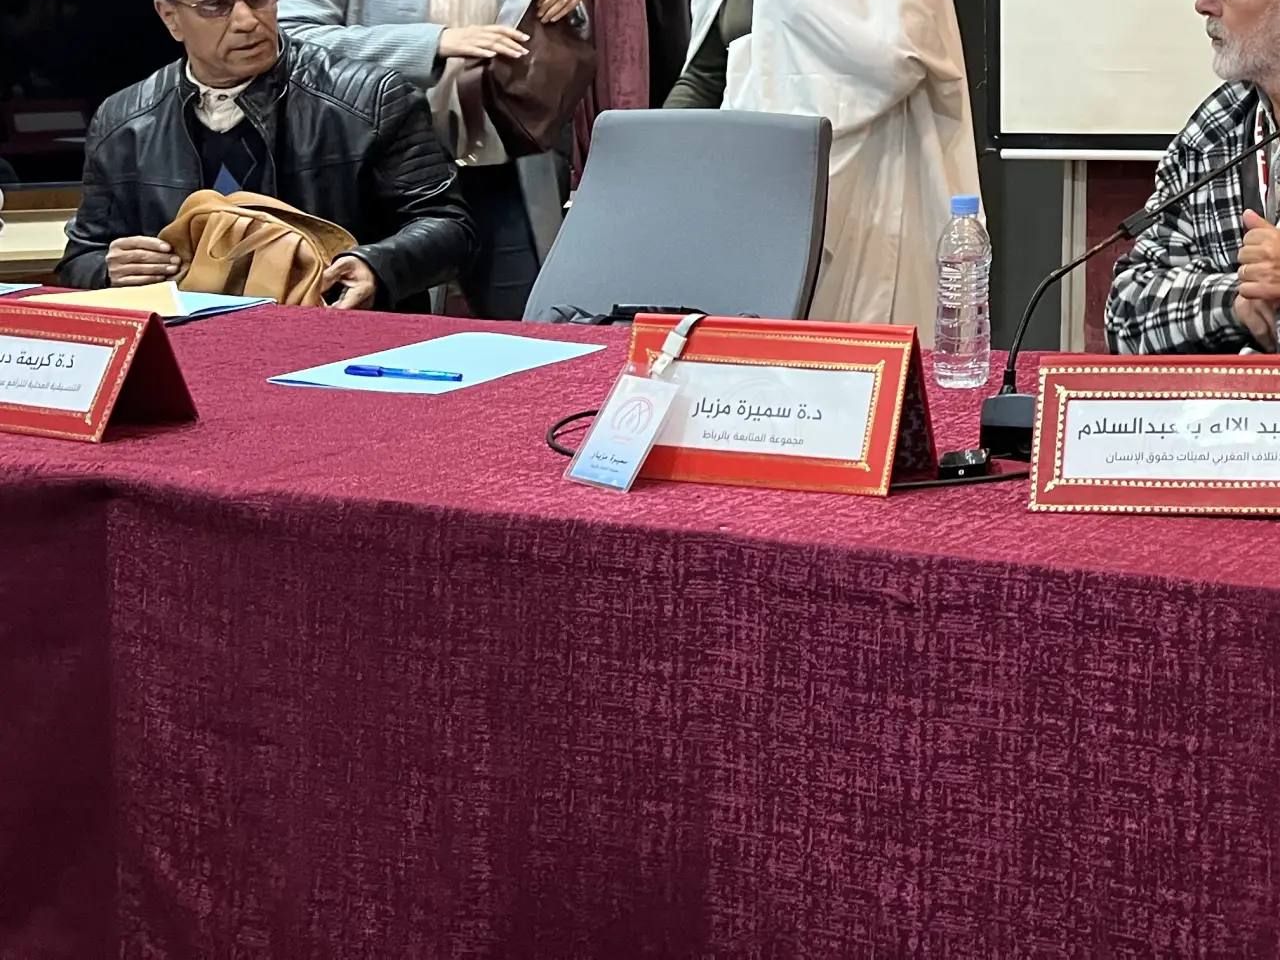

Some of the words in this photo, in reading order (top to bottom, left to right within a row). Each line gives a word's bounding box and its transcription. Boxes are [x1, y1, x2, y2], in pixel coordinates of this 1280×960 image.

[16, 351, 54, 371] كريمة
[692, 397, 731, 419] مزبار
[736, 400, 792, 422] سميرة
[1078, 417, 1179, 440] عبدالسلام
[702, 430, 730, 442] بالرباط
[733, 432, 767, 443] المتابعة
[769, 436, 804, 446] مجموعة
[1106, 451, 1144, 465] الإنسان
[1146, 452, 1174, 464] حقوق
[1176, 451, 1210, 462] لهيئات
[1212, 452, 1250, 465] المغربي
